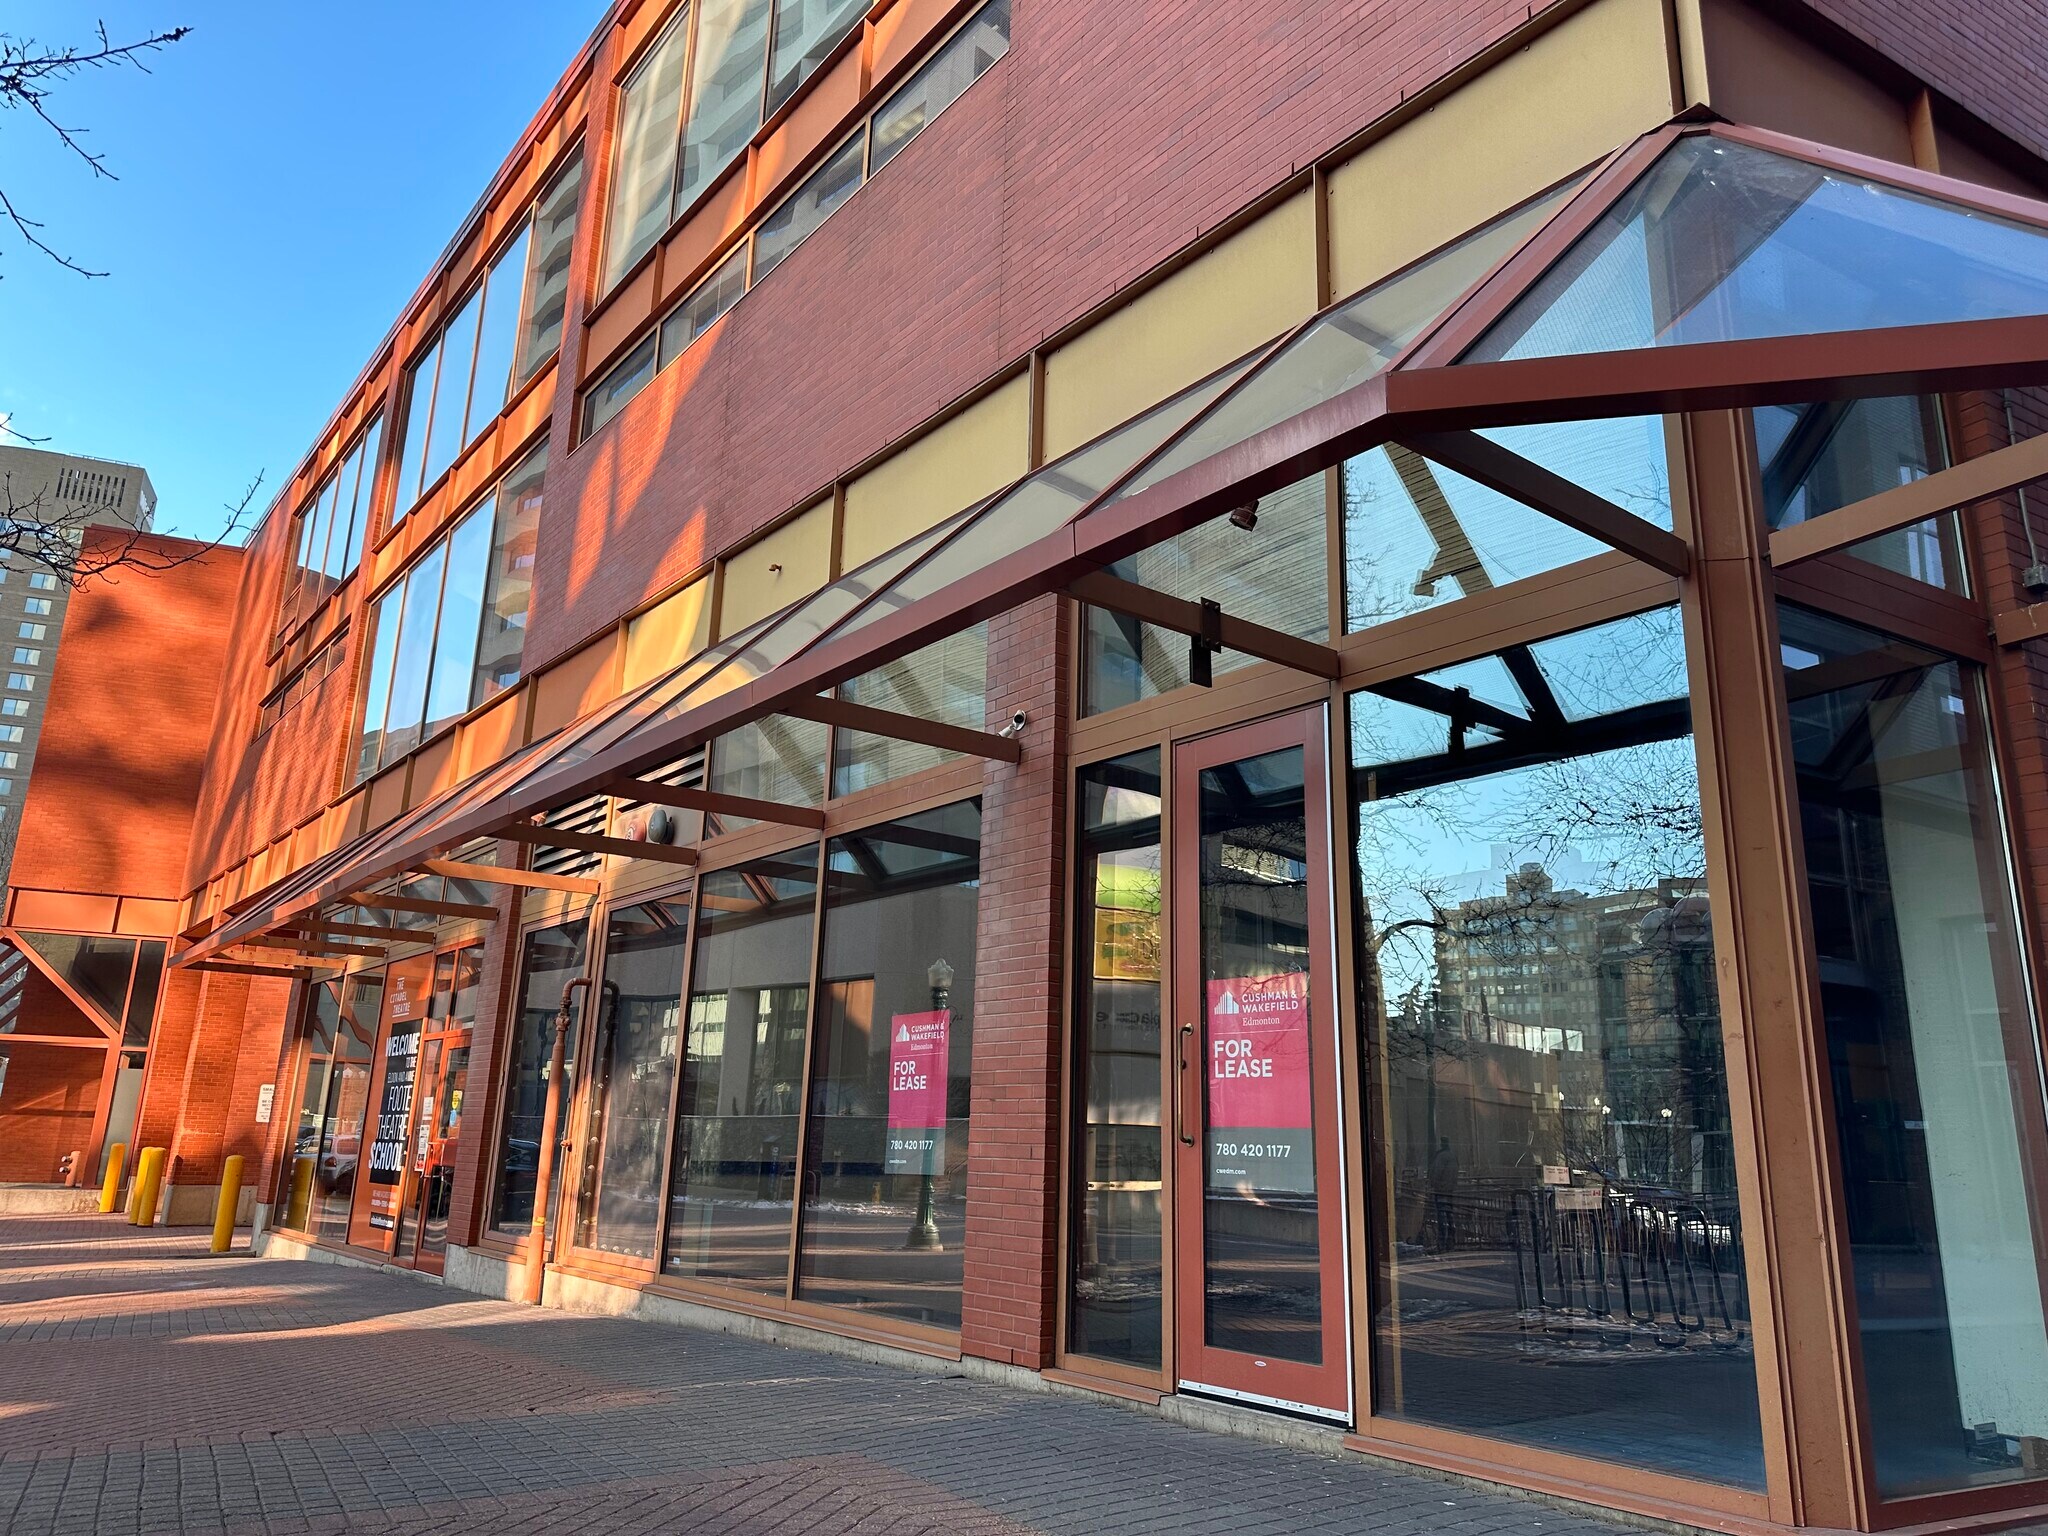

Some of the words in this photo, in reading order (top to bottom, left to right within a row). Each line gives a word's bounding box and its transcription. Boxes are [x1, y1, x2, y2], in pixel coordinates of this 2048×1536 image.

[390, 992, 407, 1003] CITADEL
[1242, 991, 1288, 1003] CUSHMAN
[1290, 989, 1298, 999] &
[393, 1002, 411, 1013] THEATRE
[1242, 1000, 1299, 1013] WAKEFIELD
[911, 1023, 940, 1033] CUSHMAN
[1242, 1017, 1280, 1027] Edmonton
[911, 1031, 945, 1041] WAKEFIELD
[385, 1032, 420, 1057] WELCOME
[911, 1043, 933, 1051] Edmonton
[1214, 1039, 1253, 1058] FOR
[894, 1060, 916, 1076] FOR
[1214, 1058, 1273, 1078] LEASE
[893, 1075, 927, 1091] LEASE
[387, 1085, 413, 1111] FOOTE
[377, 1114, 409, 1140] THEATRE
[890, 1140, 903, 1150] 780
[904, 1140, 917, 1150] 420
[919, 1140, 934, 1150] 1177
[1216, 1143, 1237, 1156] 780
[1240, 1144, 1263, 1157] 420
[1266, 1144, 1291, 1158] 1177
[368, 1142, 403, 1172] SCHOOL
